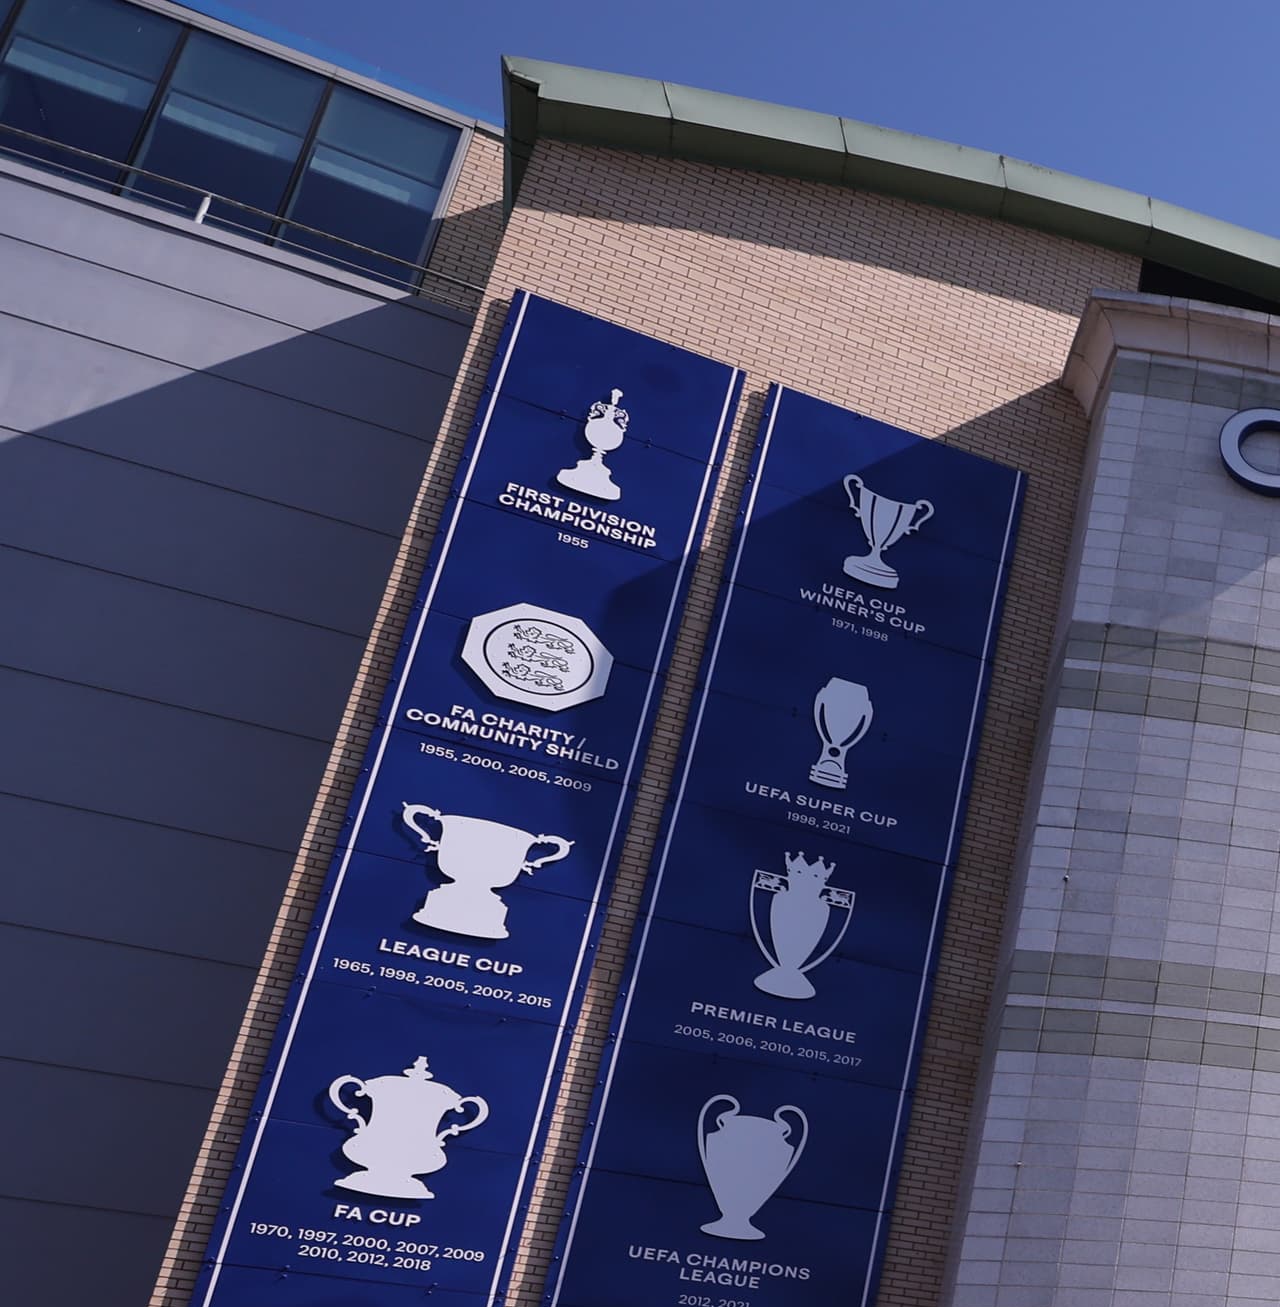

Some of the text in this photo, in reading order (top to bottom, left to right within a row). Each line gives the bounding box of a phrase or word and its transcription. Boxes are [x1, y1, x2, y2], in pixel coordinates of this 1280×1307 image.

[498, 494, 657, 550] CHAMPIONSHIP
[506, 482, 656, 538] FIRST DIVISION
[557, 531, 589, 549] 1955
[799, 588, 926, 634] WINNER'S CUP
[822, 583, 906, 615] UEFA CUP
[831, 617, 889, 642] 1971, 1998
[406, 708, 620, 770] COMMUNITY SHIELD
[451, 705, 475, 721] FA
[482, 713, 575, 746] CHARITY
[419, 742, 592, 793] 1955, 2000, 2005, 2009
[745, 781, 898, 828] UEFA SUPER CUP
[787, 811, 850, 835] 1998, 2021
[379, 938, 523, 977] LEAGUE CUP
[332, 957, 552, 1008] 1965, 1998, 2005, 2007, 2015
[690, 1001, 857, 1044] PREMIER LEAGUE
[673, 1024, 862, 1067] 2005, 2006, 2010, 2015, 2017
[333, 1204, 421, 1227] FA CUP
[249, 1222, 485, 1262] 1970, 1997, 2000, 2007, 2009
[297, 1244, 432, 1271] 2010, 2012, 2018
[628, 1245, 811, 1280] UEFA CHAMPIONS
[679, 1267, 761, 1289] LEAGUE
